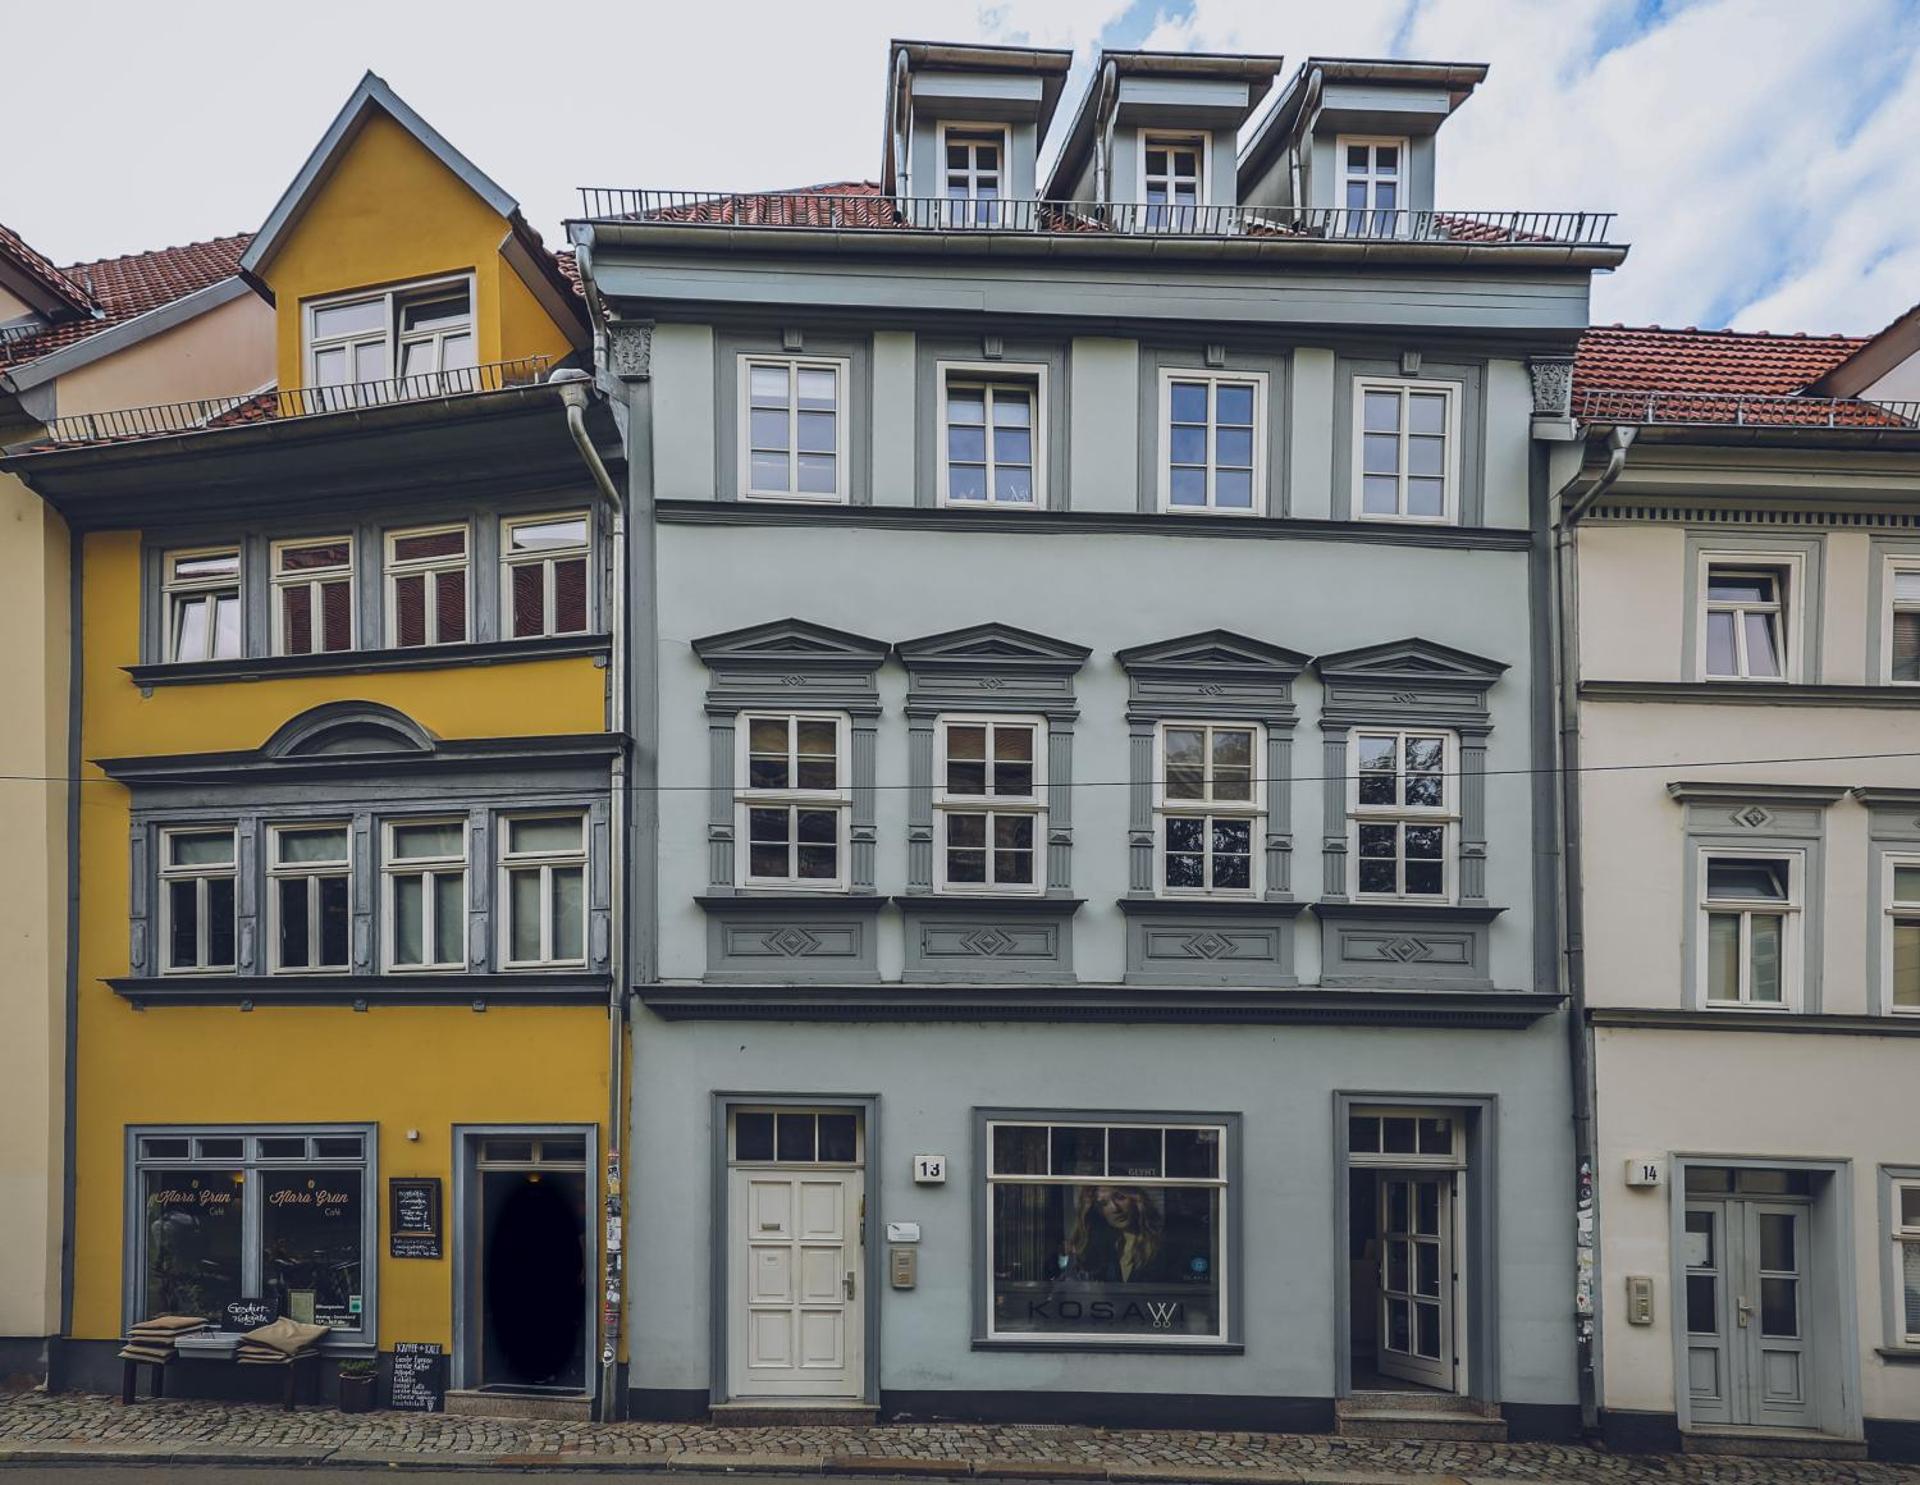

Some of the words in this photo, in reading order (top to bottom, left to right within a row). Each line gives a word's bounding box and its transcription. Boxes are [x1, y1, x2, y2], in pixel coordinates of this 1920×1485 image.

[920, 1162, 940, 1177] 13
[1643, 1166, 1656, 1180] 14
[269, 1190, 312, 1207] Klara
